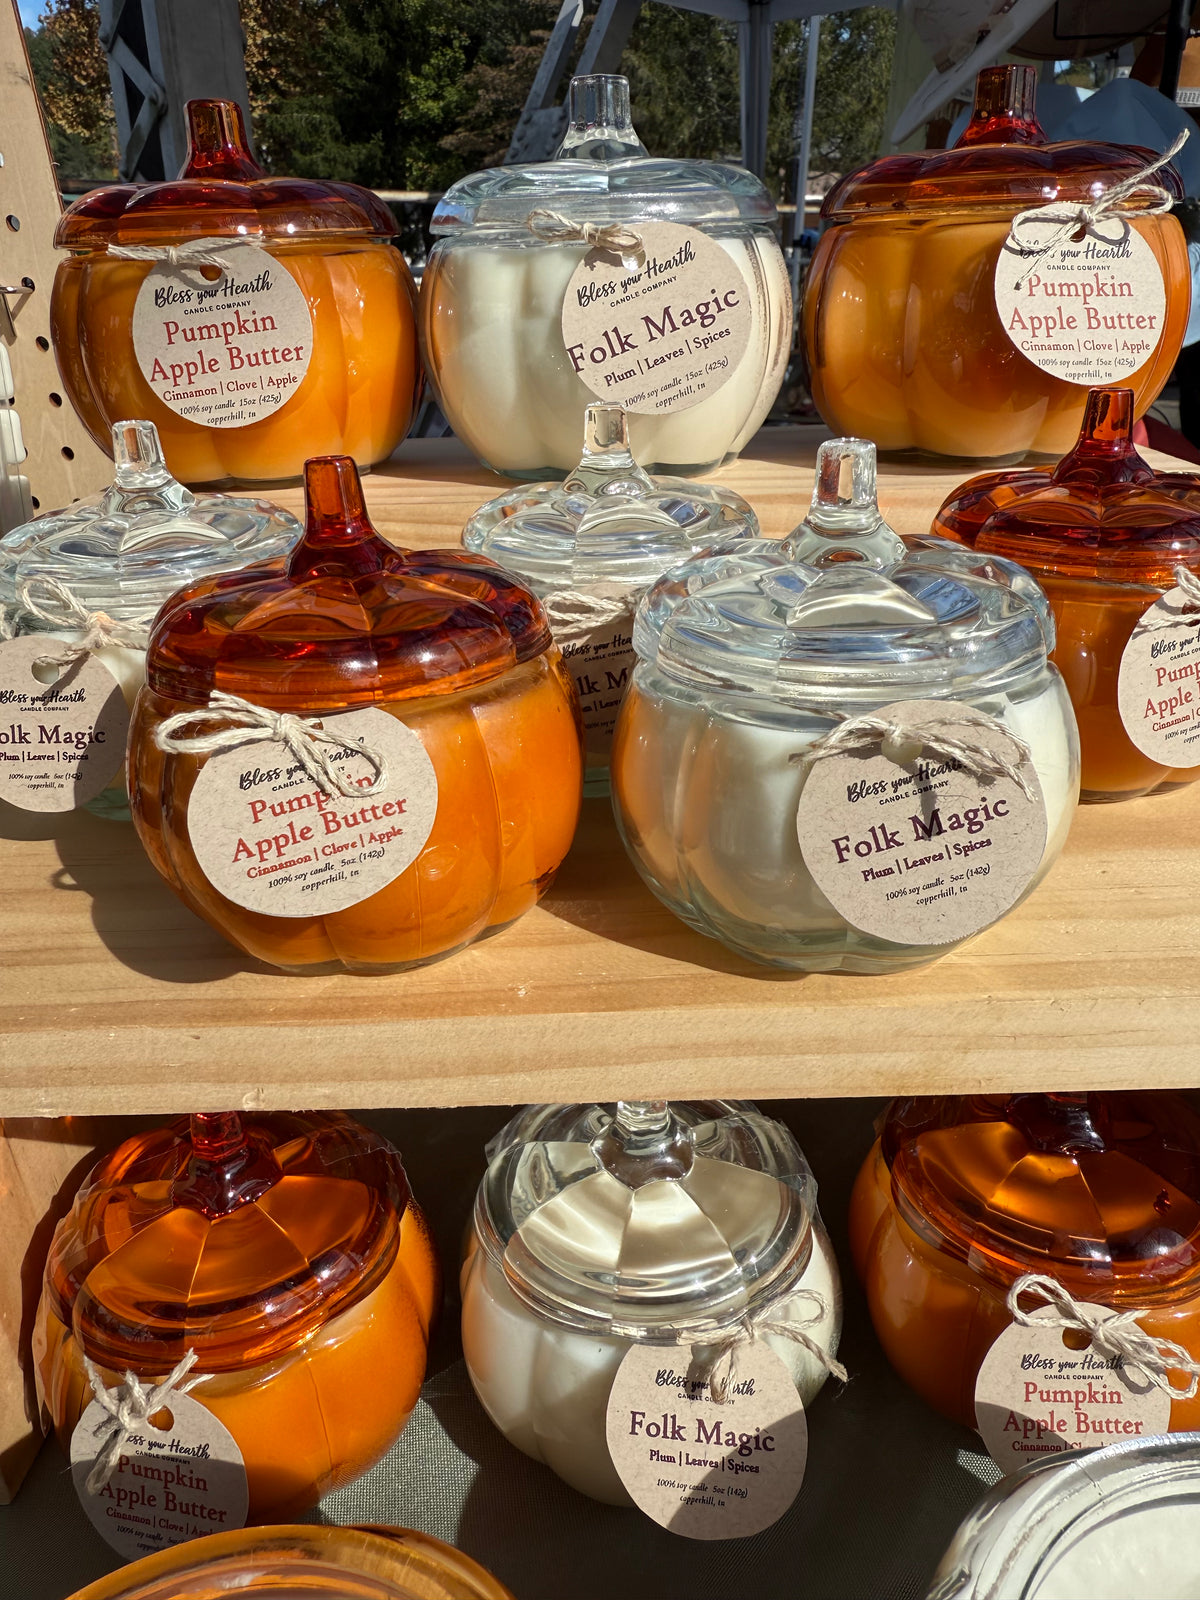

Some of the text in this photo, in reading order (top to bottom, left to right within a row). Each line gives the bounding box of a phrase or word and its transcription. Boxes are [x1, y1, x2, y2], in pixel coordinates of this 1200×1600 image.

[1061, 239, 1132, 261] your Hearth
[577, 240, 696, 307] Bless your Hearth
[154, 270, 272, 308] Bless your Hearth
[610, 276, 677, 307] CANDLE COMPANY
[1027, 273, 1133, 305] Pumpkin
[184, 301, 251, 315] CANDLE COMPANY
[163, 310, 277, 345] Pumpkin
[567, 288, 740, 372] Folk Magic
[1009, 306, 1157, 338] Apple Butter
[604, 328, 731, 387] Plum Leaves Spices
[1021, 340, 1150, 353] Cinnamon Clove Apple
[150, 345, 304, 387] Apple Butter
[1060, 360, 1070, 368] soy
[1114, 358, 1136, 367] (425g)
[1065, 370, 1103, 380] copperhill,
[163, 373, 298, 401] Cinnamon Clove Apple
[624, 356, 729, 407] 100% soy candle 15oz (425g)
[180, 392, 282, 415] 100% soy candle 15oz (425g)
[655, 386, 696, 408] copperhill,
[207, 412, 246, 425] copperhill,
[563, 634, 632, 659] Bless your Hea
[1151, 639, 1177, 659] Bless
[1179, 637, 1194, 650] your
[1170, 650, 1190, 661] CANDLE
[0, 689, 29, 704] Bless
[49, 688, 86, 703] Hearth
[1144, 686, 1193, 719] Apple
[1152, 715, 1191, 732] Cinnamon
[0, 724, 105, 749] olk Magic
[27, 752, 55, 761] Leaves
[62, 752, 88, 763] Spices
[240, 767, 283, 791] Bless
[272, 778, 305, 792] CANDLE
[847, 776, 915, 803] Bless your
[879, 780, 949, 806] CANDLE COMPANY
[232, 799, 408, 863] Apple Butter
[831, 797, 1010, 864] Folk Magic
[247, 826, 404, 879] Cinnamon Clove Apple
[861, 837, 992, 882] Plum Leaves Spices
[268, 876, 293, 888] 100%
[310, 864, 335, 877] candle
[359, 846, 386, 863] (142g)
[301, 873, 348, 892] copperhill,
[885, 889, 907, 901] 100%
[908, 885, 920, 896] soy
[922, 878, 945, 891] candle
[966, 863, 991, 879] (142g)
[916, 887, 958, 905] copperhill,
[1021, 1354, 1124, 1372] Bless your Hearth
[655, 1370, 688, 1387] Bless
[1024, 1382, 1123, 1410] Pumpkin
[629, 1410, 775, 1457] Folk Magic
[1003, 1410, 1143, 1439] Apple Butter
[127, 1434, 210, 1459] ess your Hearth
[1012, 1441, 1062, 1452] Cinnamon
[118, 1455, 208, 1492] Pumpkin
[650, 1449, 760, 1474] Plum Leaves Spices
[657, 1479, 676, 1488] 100%
[677, 1483, 687, 1492] soy
[689, 1483, 708, 1492] candle
[727, 1487, 748, 1498] (142g)
[680, 1495, 716, 1507] copperhill,
[99, 1481, 227, 1523] Apple Butter
[106, 1507, 184, 1532] Cinnamon Clove
